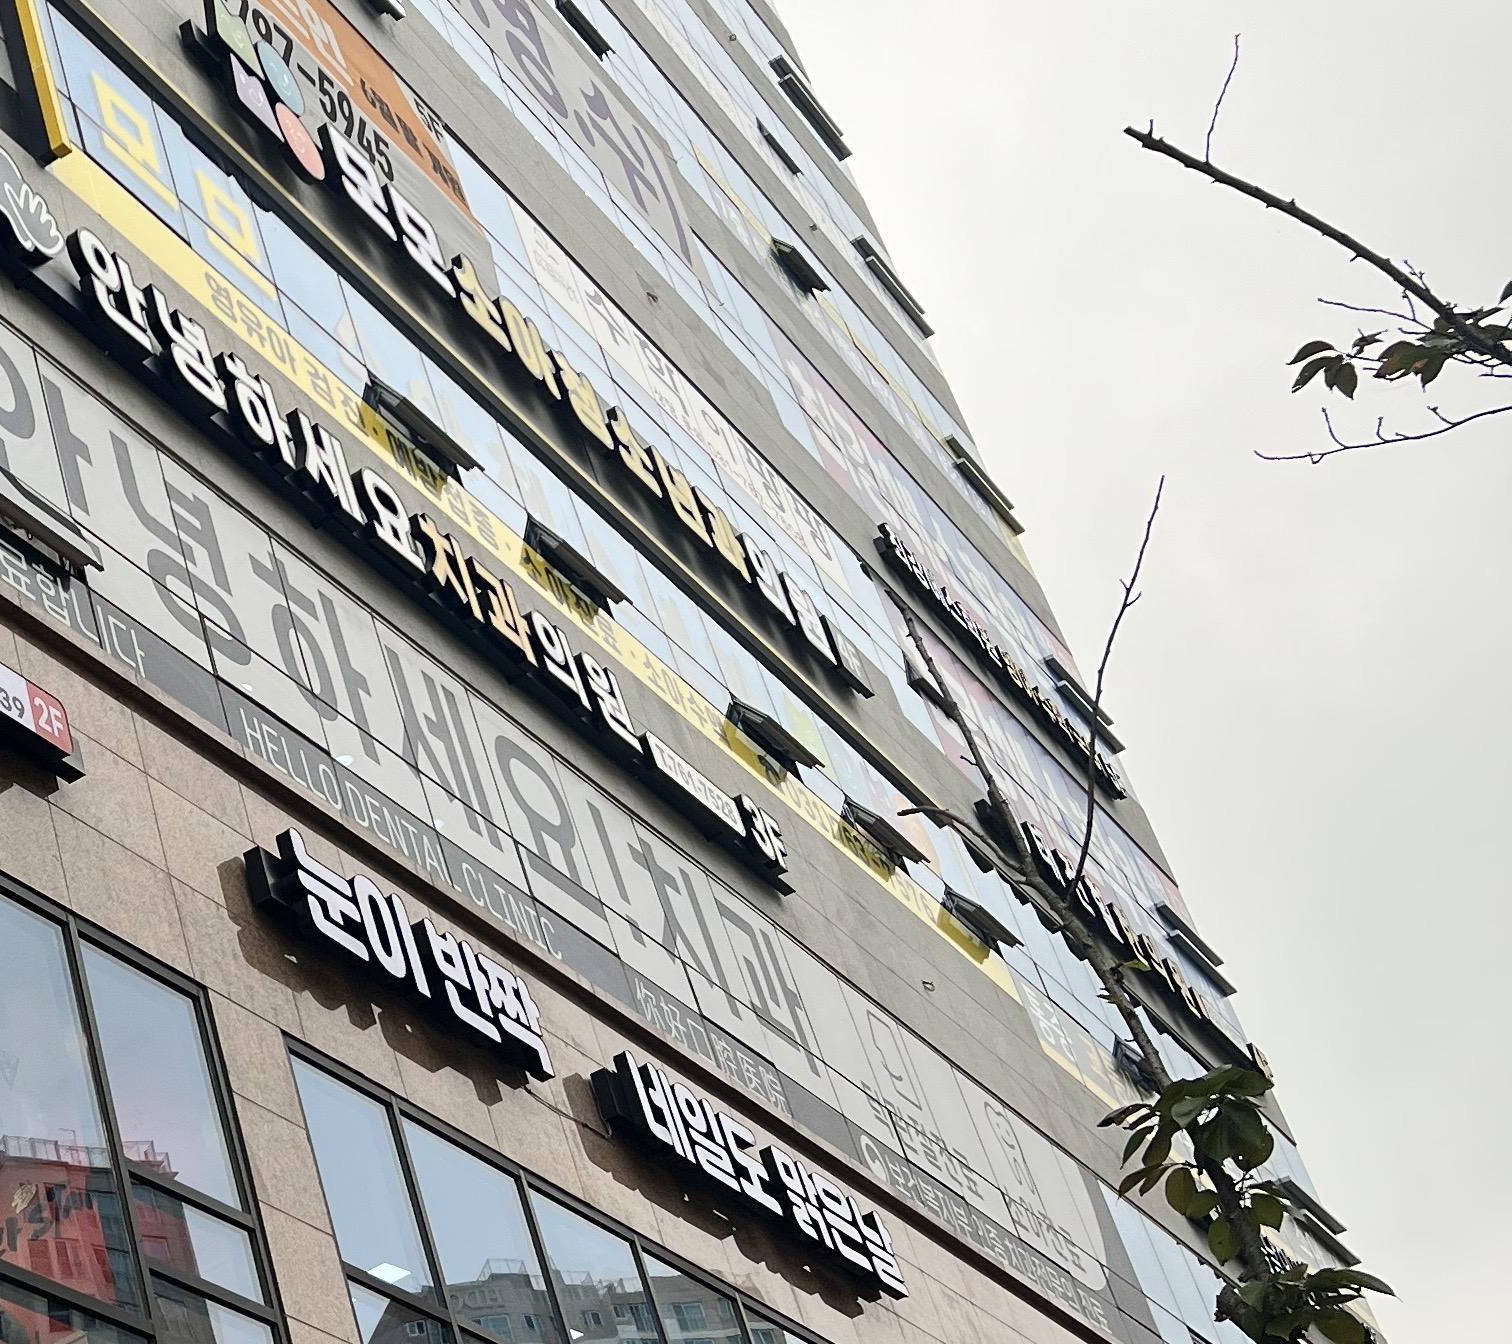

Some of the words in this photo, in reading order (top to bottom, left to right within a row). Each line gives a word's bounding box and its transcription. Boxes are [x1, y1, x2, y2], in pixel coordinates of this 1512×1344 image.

[91, 67, 280, 304] 모모
[413, 95, 446, 150] 5F
[203, 267, 298, 378] 영유아
[301, 352, 368, 439] 검진
[76, 228, 643, 752] 안녕하세요치과의원
[32, 698, 66, 740] 2F
[239, 705, 345, 816] HELLO
[345, 771, 466, 896] DENTAL
[461, 861, 564, 960] CLINIC
[735, 794, 788, 864] 3F
[289, 829, 431, 999] 눈이
[426, 918, 555, 1082] 반짝
[632, 978, 788, 1112] 你好口腔医院
[618, 1051, 783, 1217] 네일도
[768, 1143, 910, 1300] 맑은날
